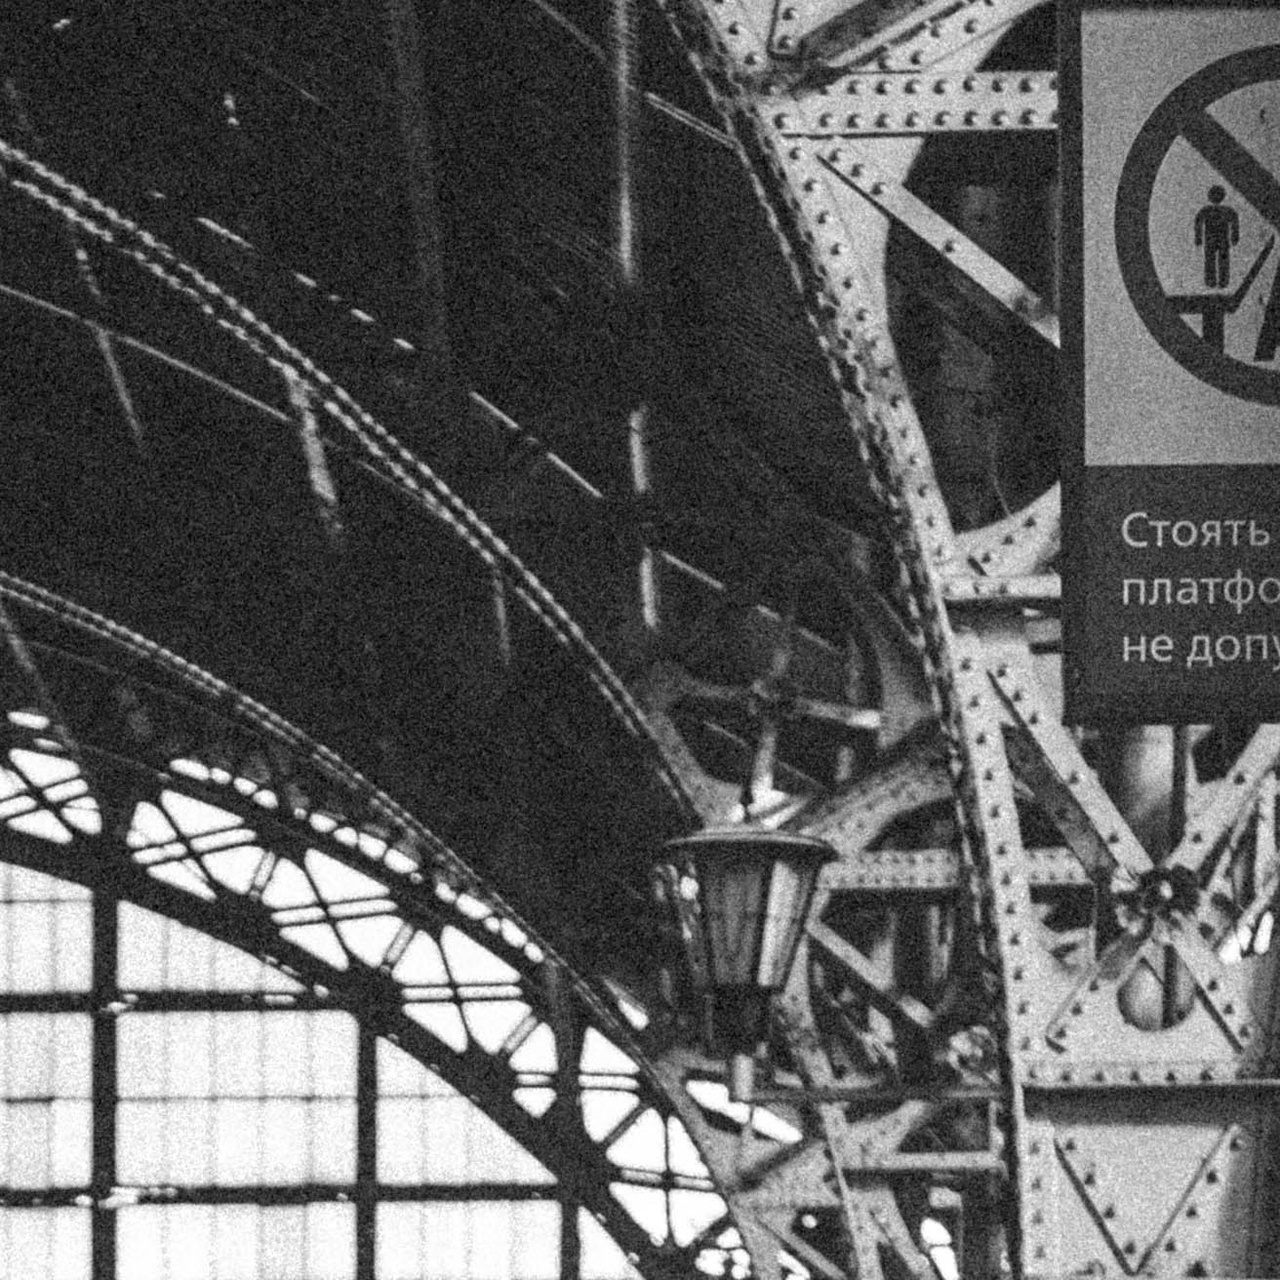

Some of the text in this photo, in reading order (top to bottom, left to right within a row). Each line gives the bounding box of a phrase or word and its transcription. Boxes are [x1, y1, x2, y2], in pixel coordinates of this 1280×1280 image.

[1121, 511, 1271, 548] Стоять
[1122, 568, 1280, 615] платфо
[1122, 633, 1174, 662] не
